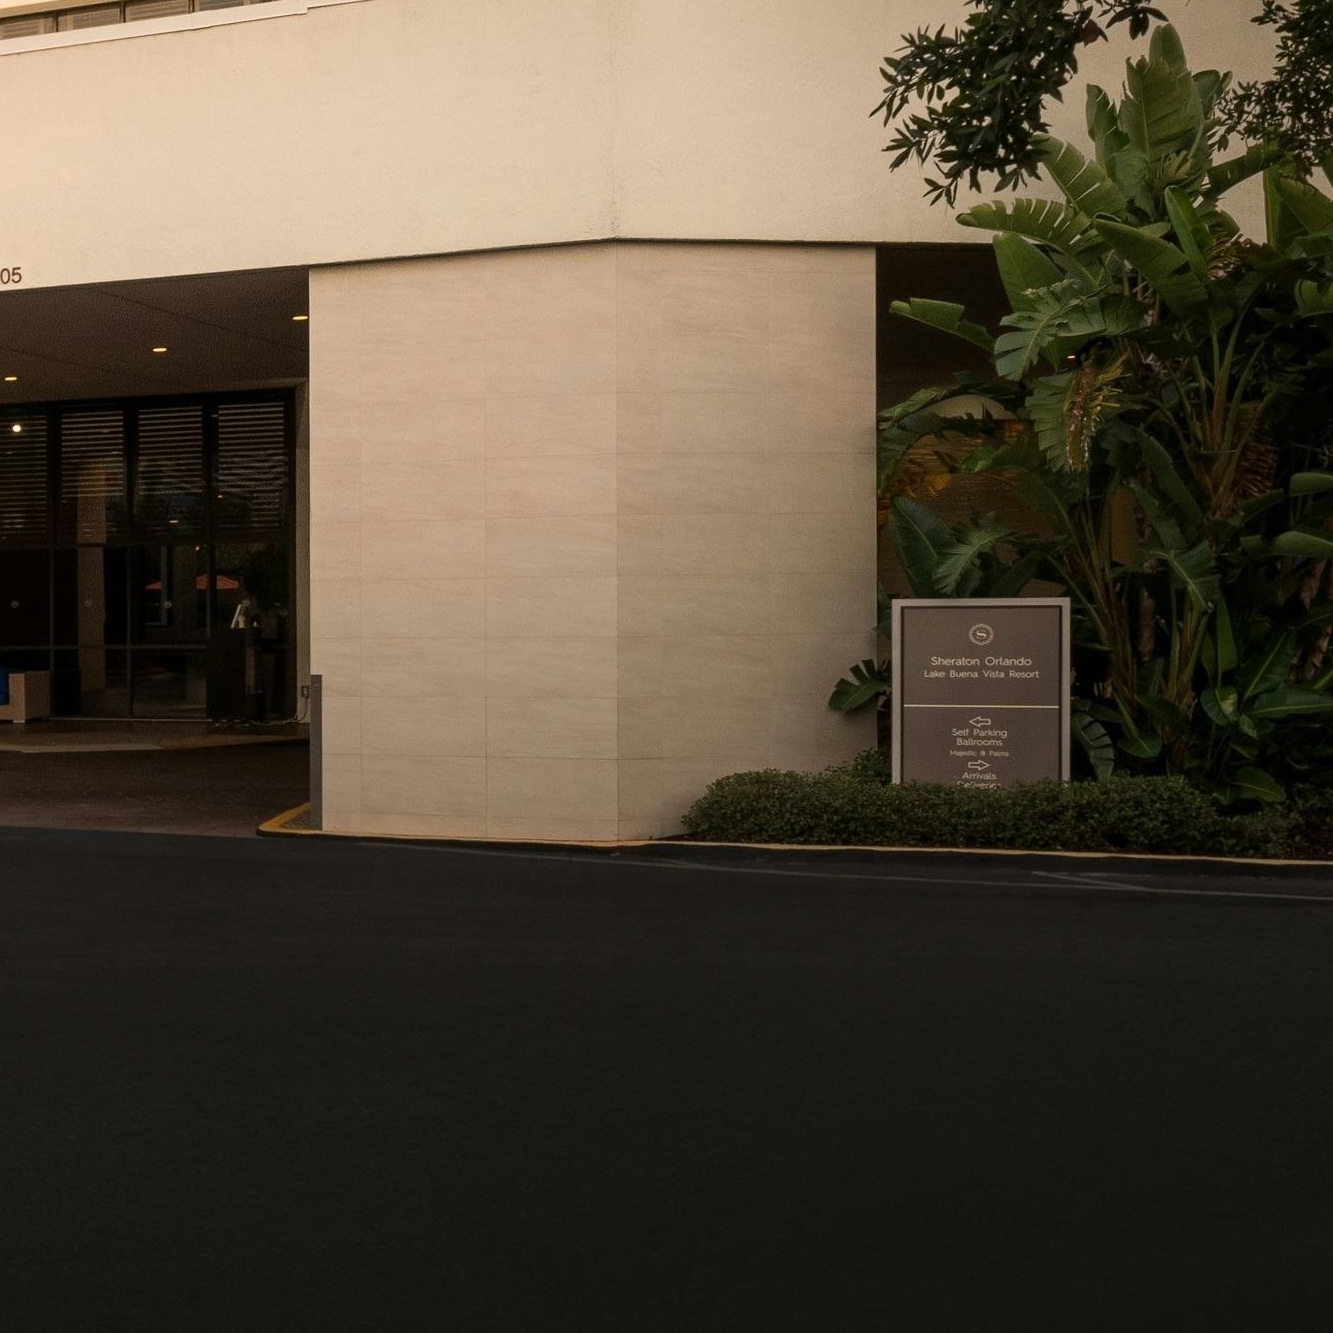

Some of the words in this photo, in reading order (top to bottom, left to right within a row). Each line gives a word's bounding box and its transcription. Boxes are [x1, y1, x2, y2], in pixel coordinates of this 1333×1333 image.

[931, 656, 980, 666] Sheraton
[985, 656, 1033, 666] Orlando
[924, 670, 946, 678] Lake
[949, 670, 979, 678] Buena
[982, 670, 1005, 678] Vista
[1009, 670, 1040, 678] Resort
[952, 728, 969, 736] Self
[973, 728, 1008, 738] Parking
[956, 738, 1003, 746] Ballrooms
[962, 772, 997, 780] Arrivals
